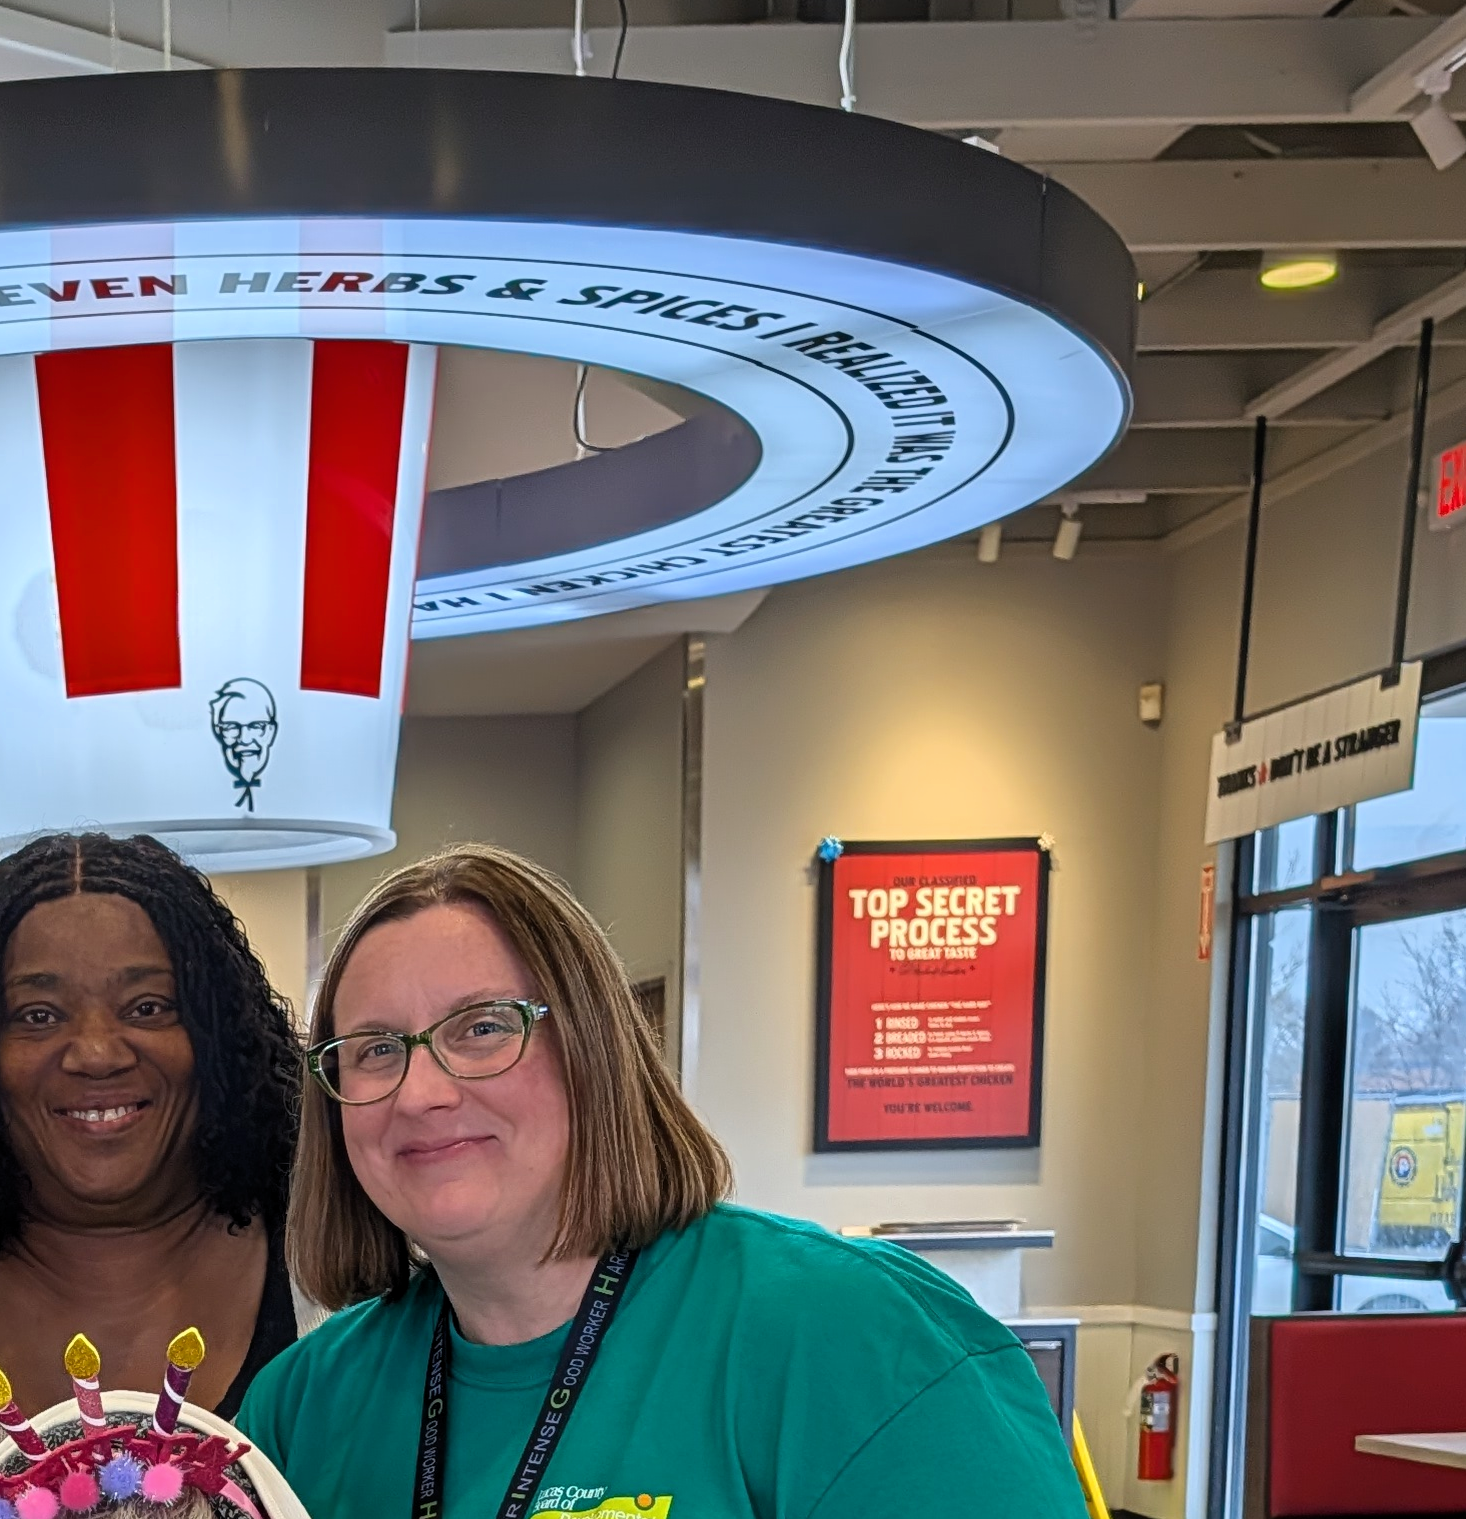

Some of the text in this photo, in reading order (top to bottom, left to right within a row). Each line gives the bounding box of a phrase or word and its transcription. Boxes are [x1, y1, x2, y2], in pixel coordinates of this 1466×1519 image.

[218, 271, 476, 295] HERBS
[485, 278, 547, 301] &
[557, 284, 785, 331] SPICES
[782, 331, 948, 409] REALIZED
[891, 411, 956, 427] IT
[885, 430, 956, 463] WAS
[849, 467, 935, 493] THE
[717, 497, 884, 560] GREATEST
[514, 555, 708, 597] CHICKEN
[413, 596, 479, 613] HA
[849, 885, 1021, 919] TOP SECRET
[870, 917, 997, 949] PROCESS
[889, 946, 977, 960] TO GREAT TASTE
[511, 1411, 563, 1501] INTENSE
[550, 1358, 585, 1410] GOOD
[576, 1299, 611, 1357] WORKER
[420, 1447, 437, 1499] WORKER
[561, 1498, 576, 1511] of
[566, 1485, 608, 1500] County
